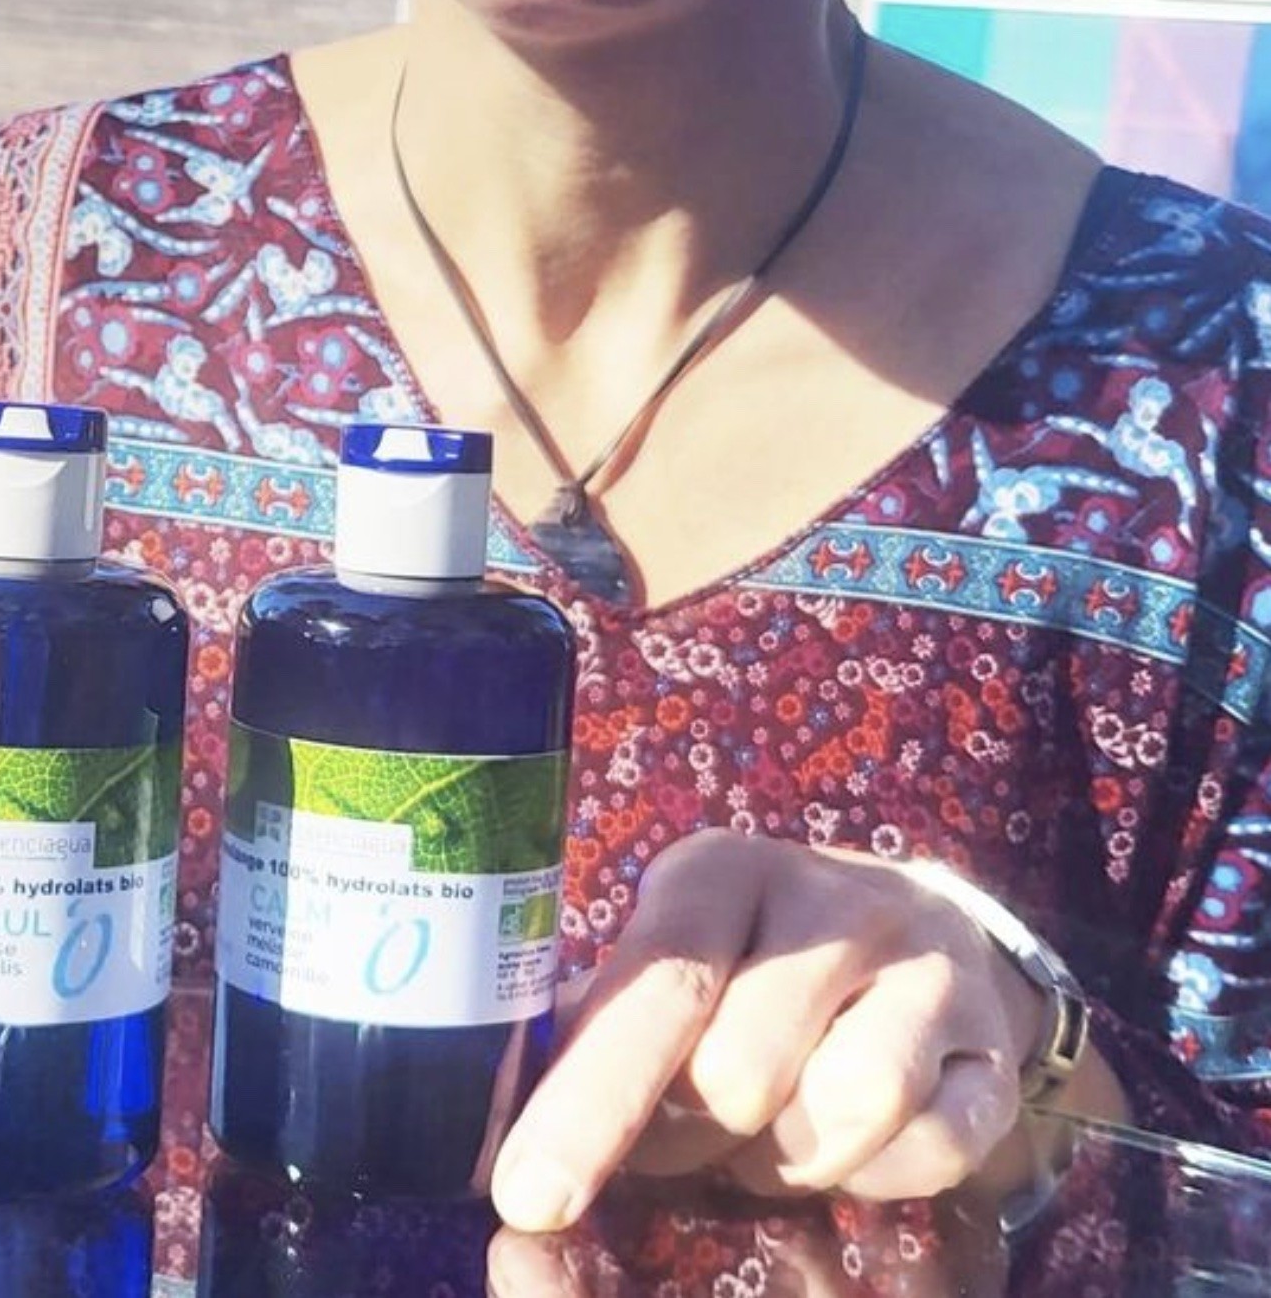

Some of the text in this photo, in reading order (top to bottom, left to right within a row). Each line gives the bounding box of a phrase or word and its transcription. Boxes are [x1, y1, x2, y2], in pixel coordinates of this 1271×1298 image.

[12, 874, 115, 899] hydrolats
[118, 873, 145, 892] bio
[325, 872, 435, 899] hydrolats
[440, 883, 475, 900] bio
